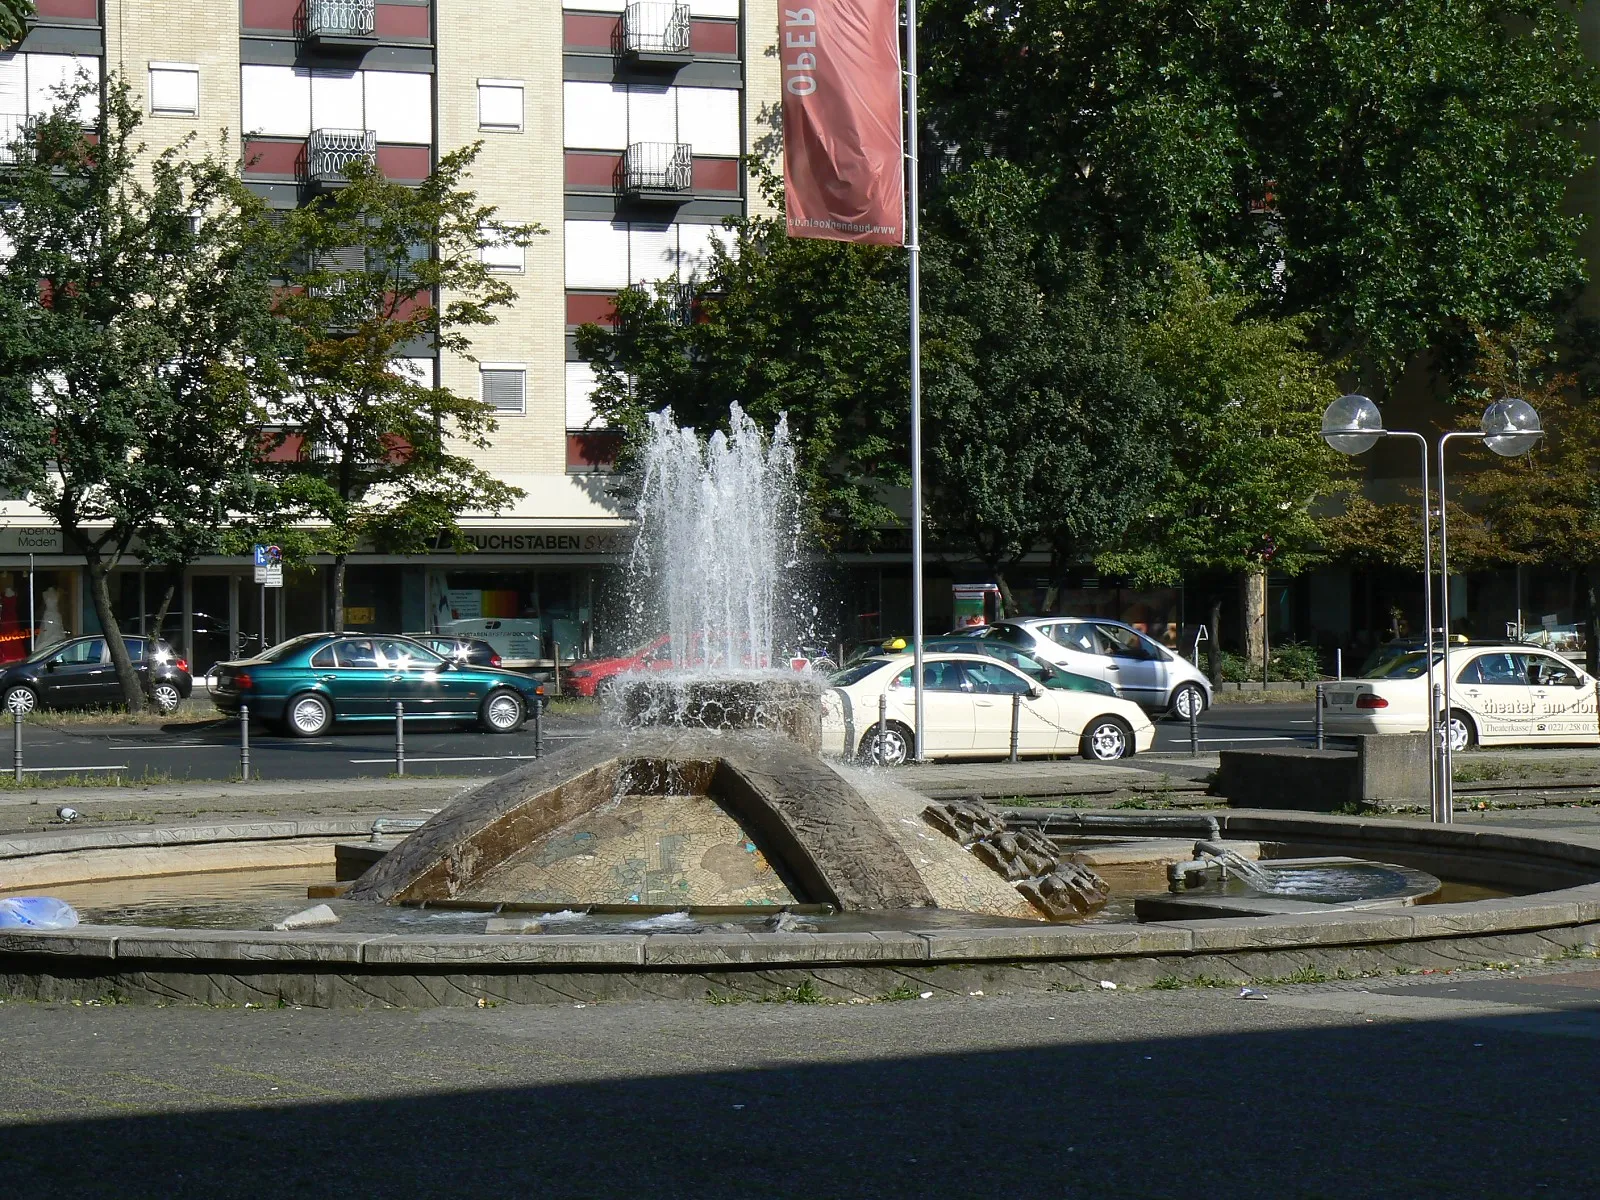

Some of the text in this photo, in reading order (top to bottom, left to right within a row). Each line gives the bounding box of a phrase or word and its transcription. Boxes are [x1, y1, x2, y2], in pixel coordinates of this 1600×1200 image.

[18, 537, 57, 547] Moden
[1483, 699, 1536, 714] theater
[1543, 703, 1566, 714] am
